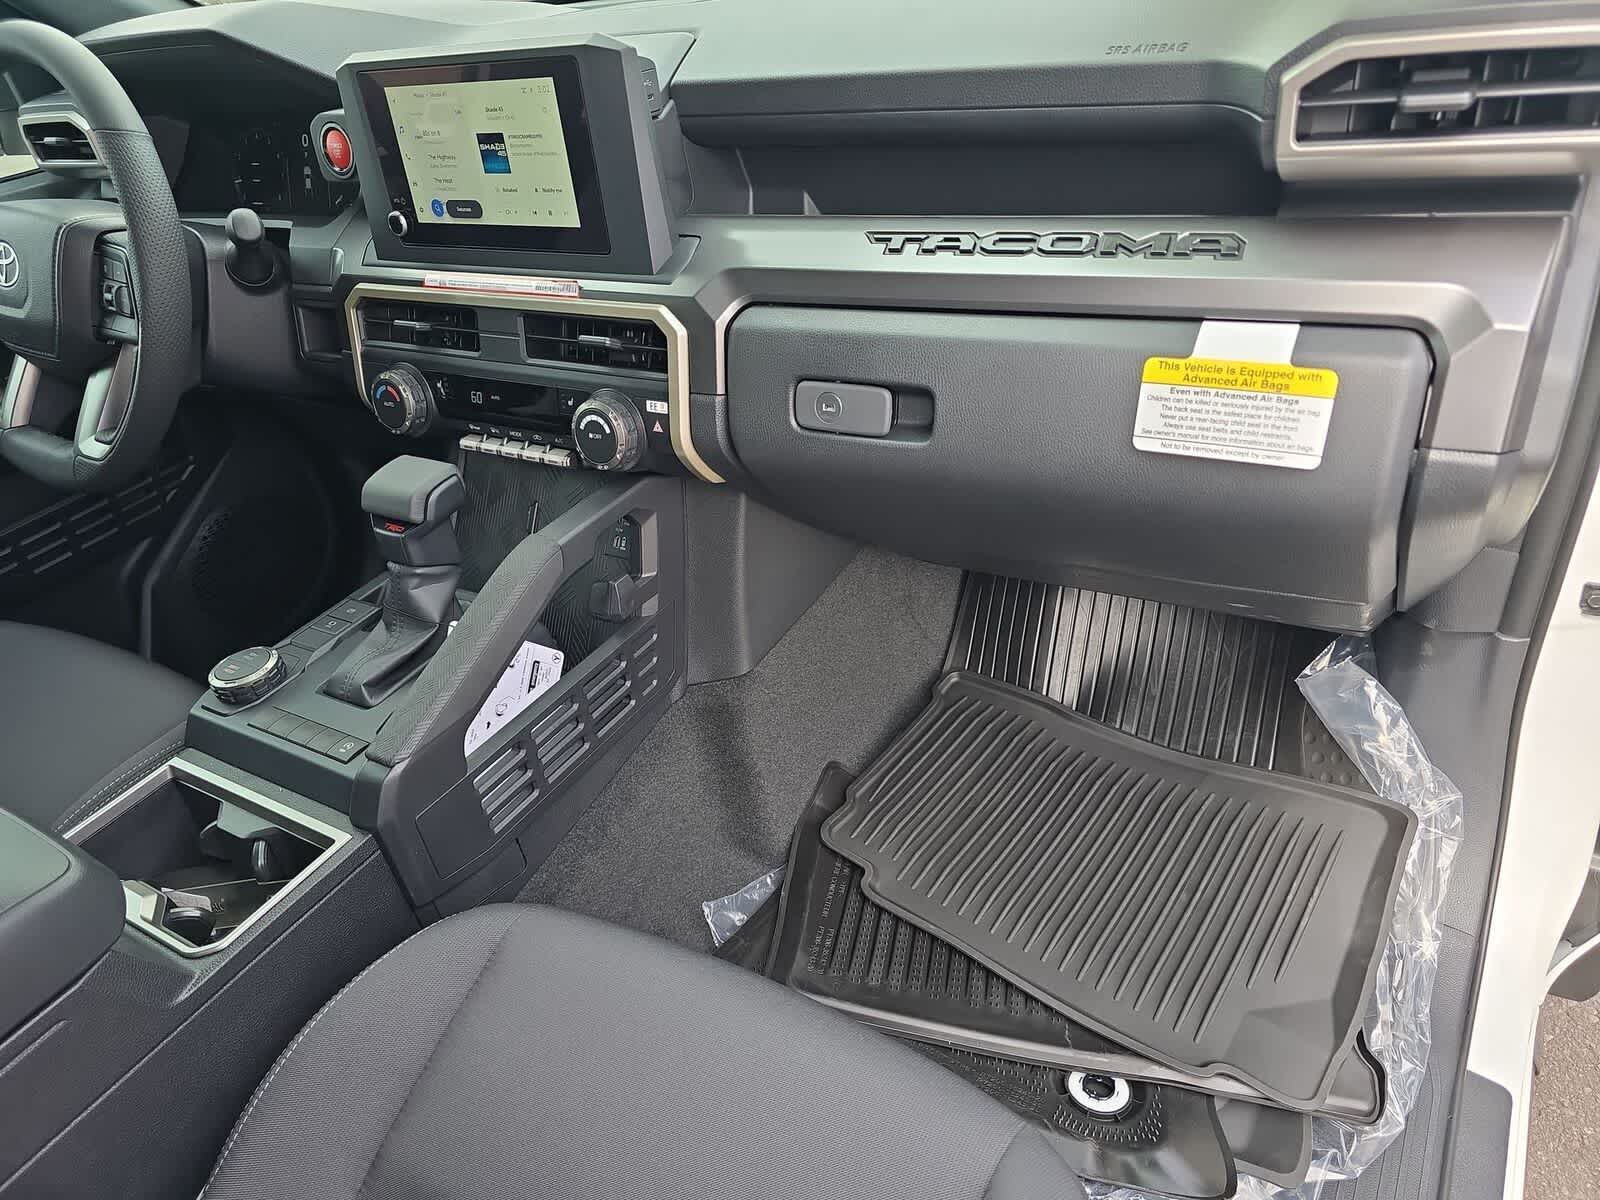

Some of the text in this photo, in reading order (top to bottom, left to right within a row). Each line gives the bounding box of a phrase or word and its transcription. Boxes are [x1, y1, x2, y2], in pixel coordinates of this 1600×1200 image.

[1105, 41, 1190, 56] SRS AIRBAG
[480, 143, 506, 151] SHADE
[863, 230, 1249, 260] TACOMA
[1159, 360, 1180, 371] This
[1184, 362, 1223, 375] Vehicle
[1239, 366, 1294, 380] Equipped
[1297, 371, 1322, 383] with
[1182, 373, 1290, 393] Advanced Air Bags
[471, 391, 483, 404] 60
[1147, 394, 1171, 403] Children
[1195, 398, 1211, 406] killed
[1221, 401, 1249, 410] seriously
[1251, 404, 1273, 412] injured
[1170, 386, 1300, 406] Even with Advanced Air Bags
[1161, 403, 1172, 411] The
[1163, 421, 1184, 430] Always
[1228, 437, 1265, 446] information
[1192, 446, 1224, 454] removed
[1225, 450, 1249, 458] except
